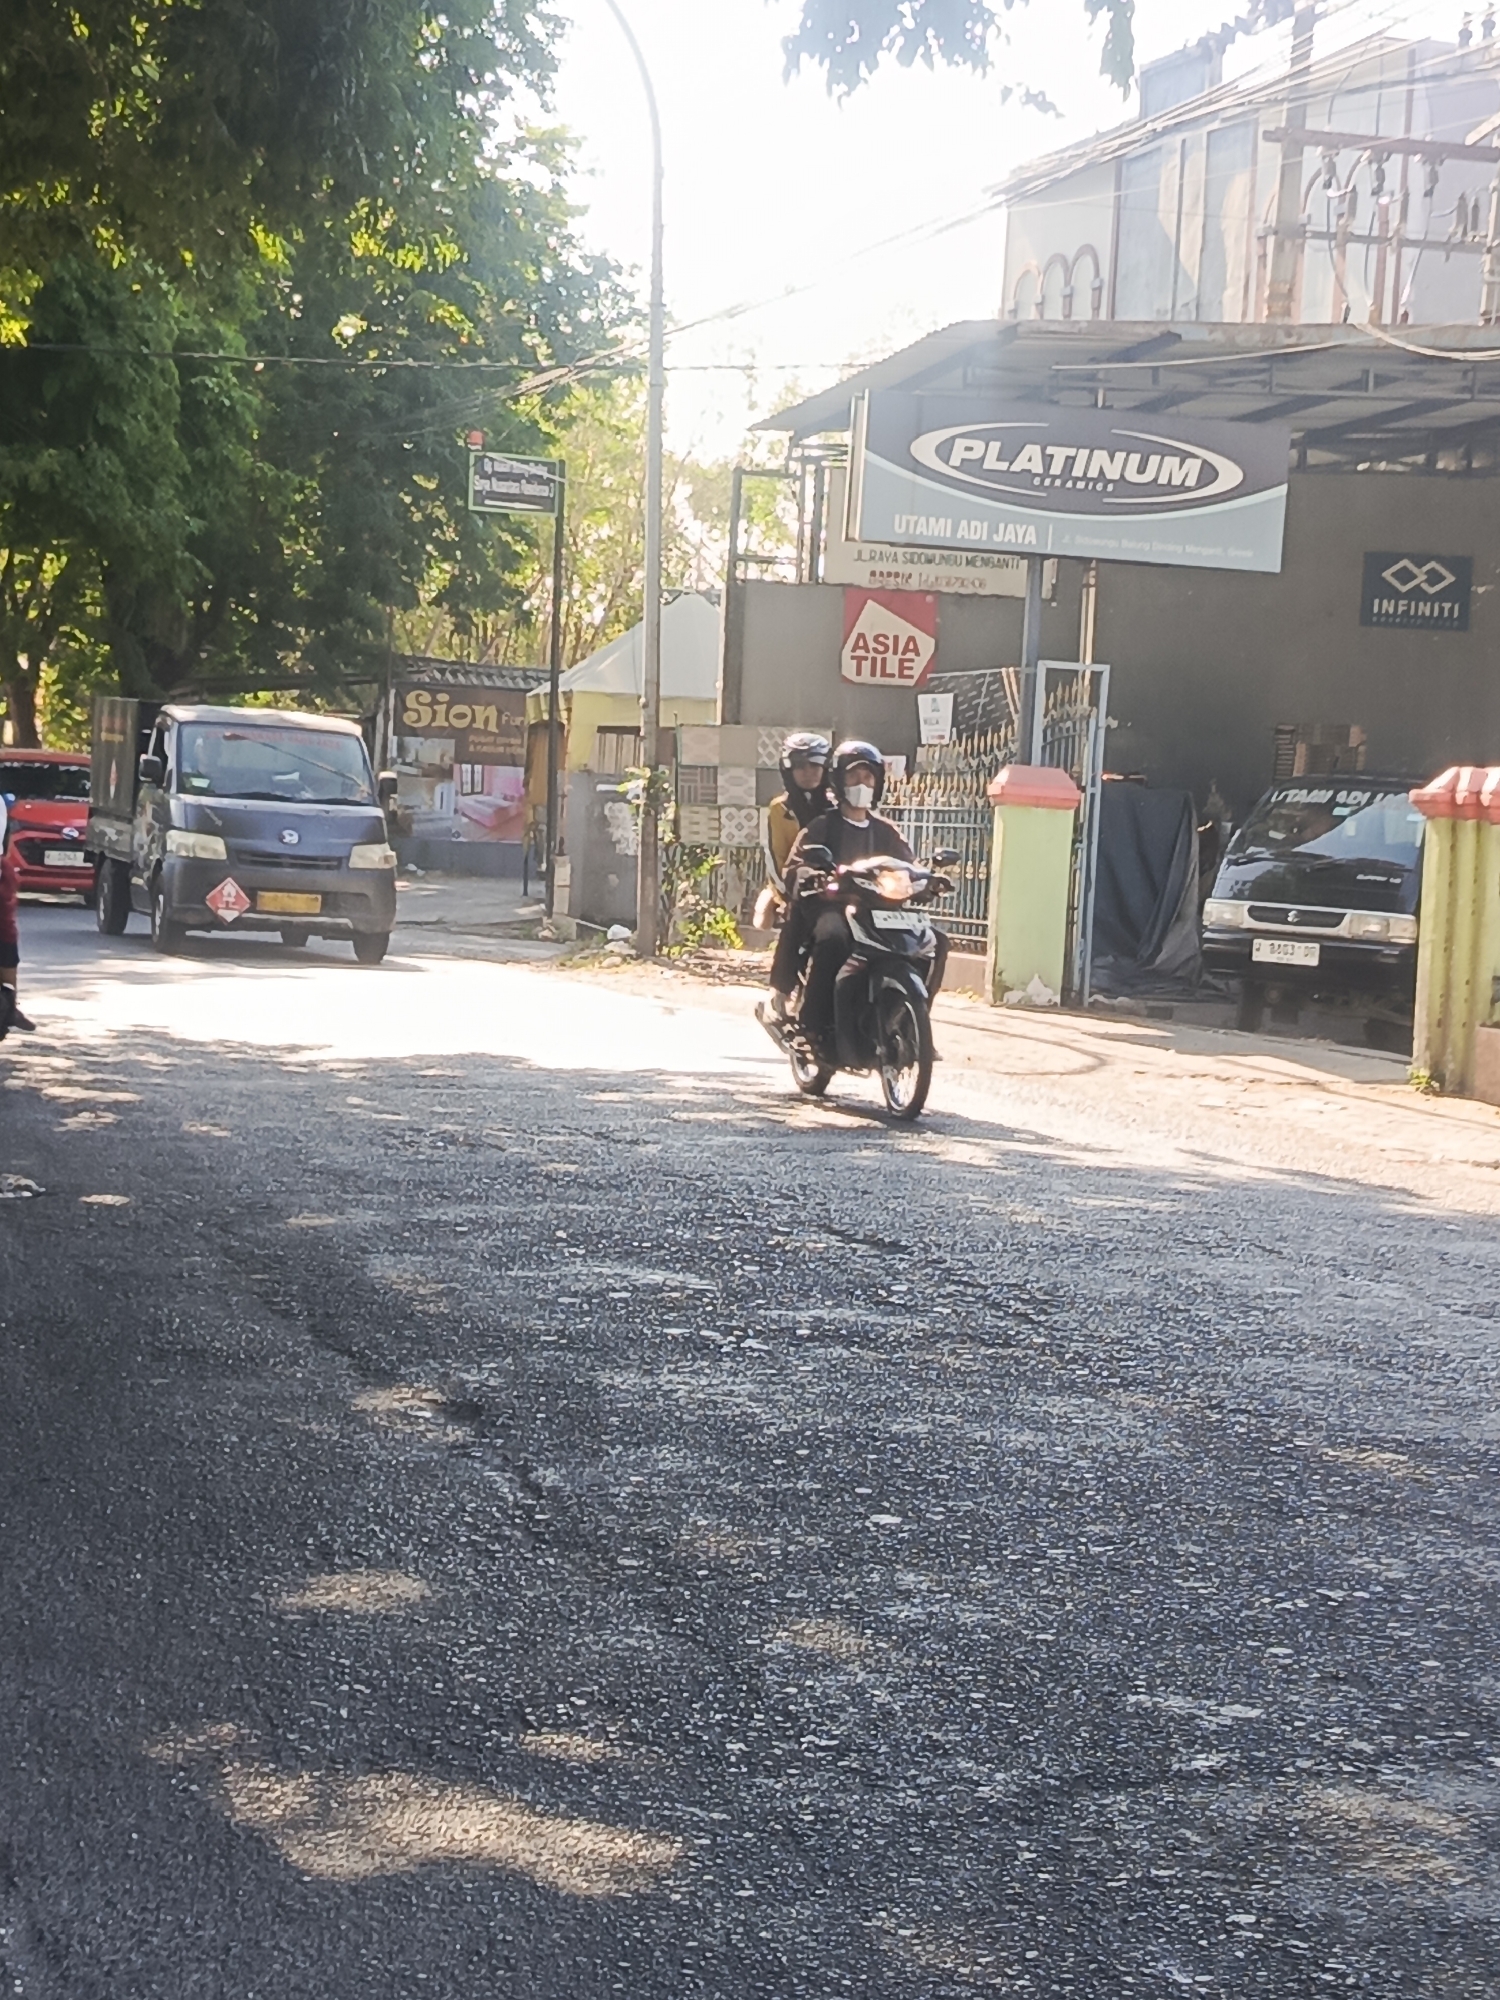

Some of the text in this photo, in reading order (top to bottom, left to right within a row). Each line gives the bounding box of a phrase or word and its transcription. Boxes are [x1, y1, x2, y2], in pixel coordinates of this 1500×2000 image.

[948, 437, 1202, 487] PLATINUM
[1032, 476, 1114, 492] CERAMICS
[894, 513, 1037, 545] UTAMI ADI JAYA
[1373, 598, 1459, 619] INFINITI
[850, 632, 921, 657] ASIA
[850, 655, 915, 680] TILE
[402, 690, 499, 733] Sion
